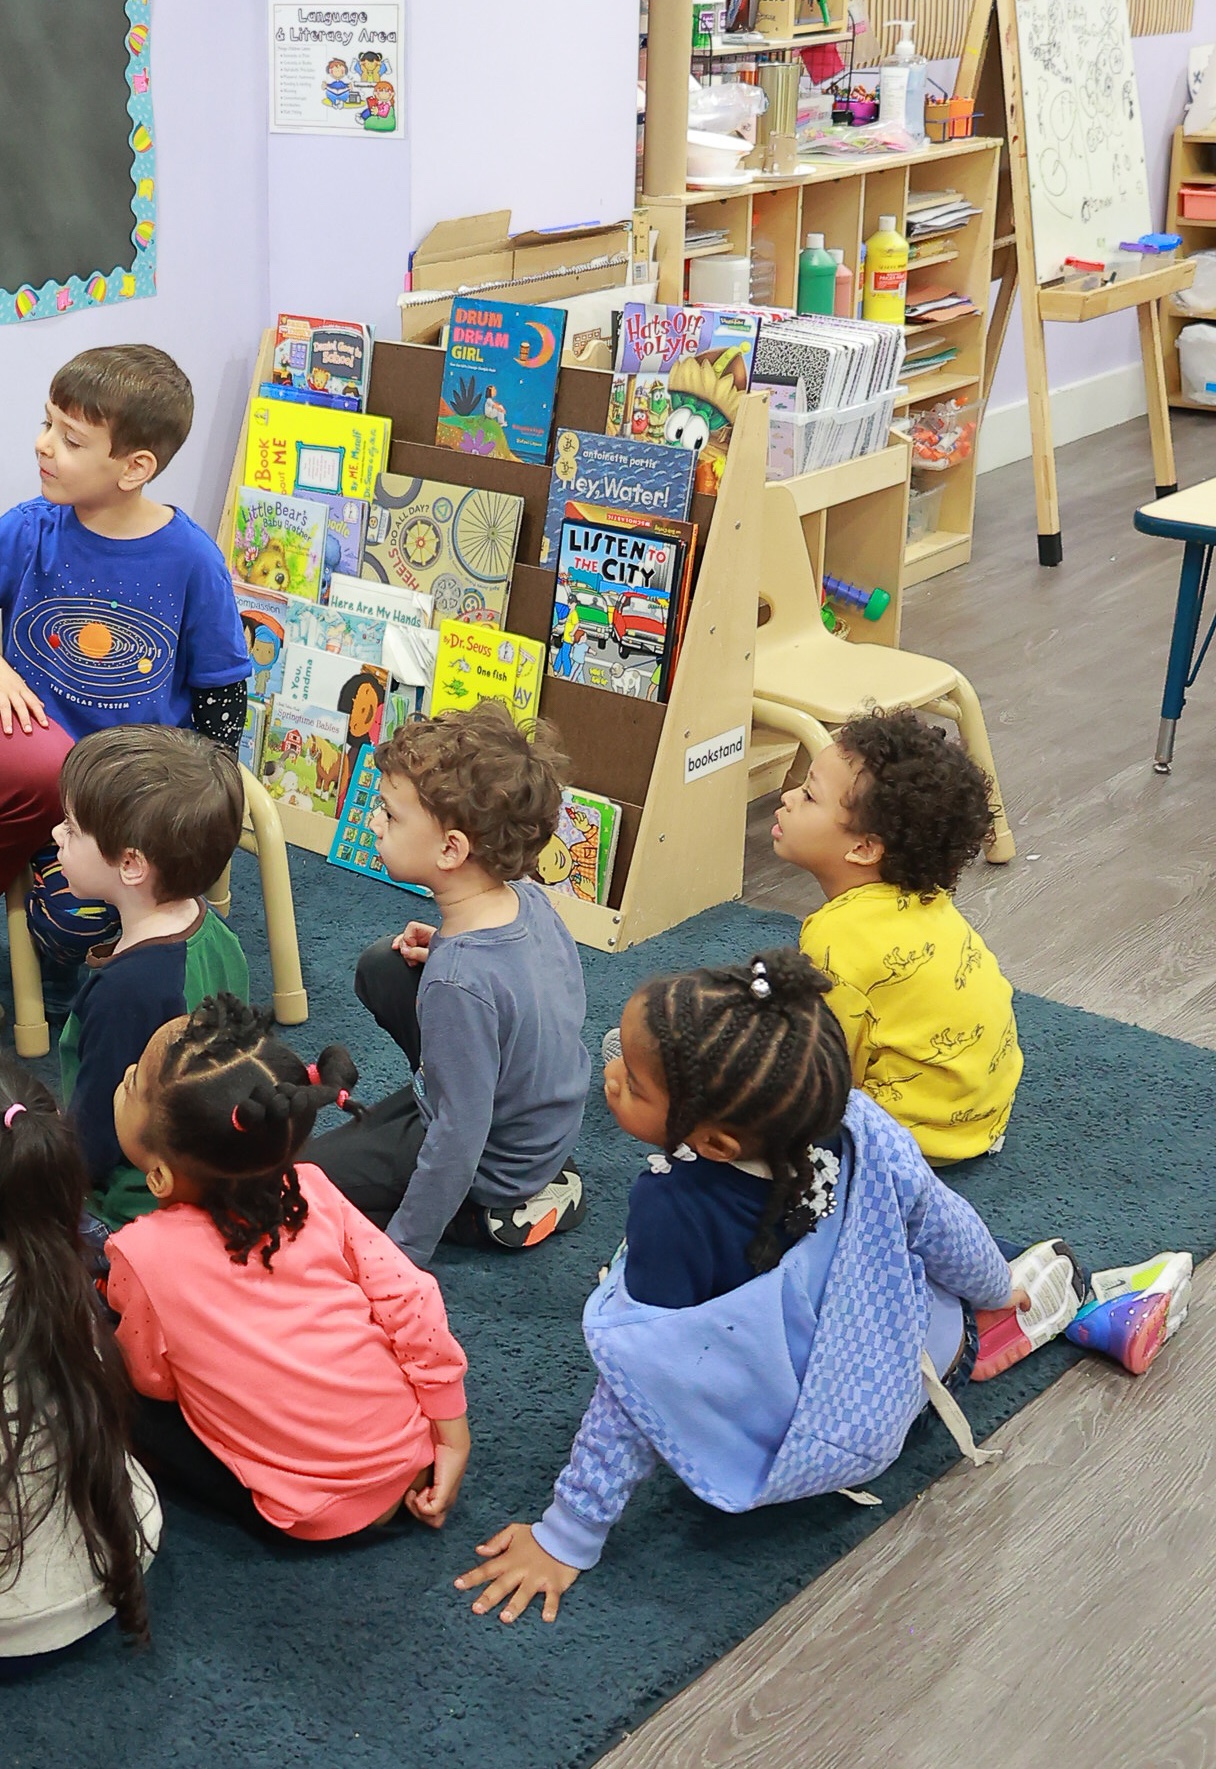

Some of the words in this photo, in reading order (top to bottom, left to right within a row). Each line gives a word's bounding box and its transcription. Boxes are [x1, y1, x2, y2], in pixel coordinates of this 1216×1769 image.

[298, 8, 368, 26] Language
[275, 27, 285, 42] &
[289, 27, 353, 46] Literacy
[358, 28, 397, 43] Area
[455, 308, 503, 328] DRUM
[626, 313, 673, 343] Hats
[673, 312, 706, 336] Off
[452, 327, 509, 349] DREAM
[634, 338, 654, 361] to
[655, 333, 699, 362] Lyle
[322, 351, 355, 368] School
[451, 345, 484, 362] GIRL
[273, 438, 287, 465] ME
[583, 449, 628, 464] antoinette
[629, 457, 658, 469] portis
[604, 475, 670, 508] Water!
[242, 502, 273, 523] Little
[275, 502, 308, 526] Bear's
[390, 530, 398, 546] DO
[395, 511, 409, 529] ALL
[408, 504, 430, 515] DAY?
[264, 518, 282, 530] Baby
[284, 520, 312, 541] Brother
[569, 529, 646, 560] LISTEN
[648, 549, 666, 563] TO
[574, 557, 598, 572] THE
[602, 558, 655, 587] CITY
[331, 596, 354, 611] Here
[356, 601, 373, 615] Are
[376, 607, 391, 619] My
[393, 611, 421, 628] Hands
[450, 633, 464, 649] Dr.
[466, 635, 492, 658] Seuss
[477, 665, 491, 678] One
[493, 669, 507, 681] fish
[50, 683, 63, 697] THE
[65, 693, 93, 707] SOLAR
[277, 708, 315, 729] Springtime
[688, 735, 743, 772] bookstand
